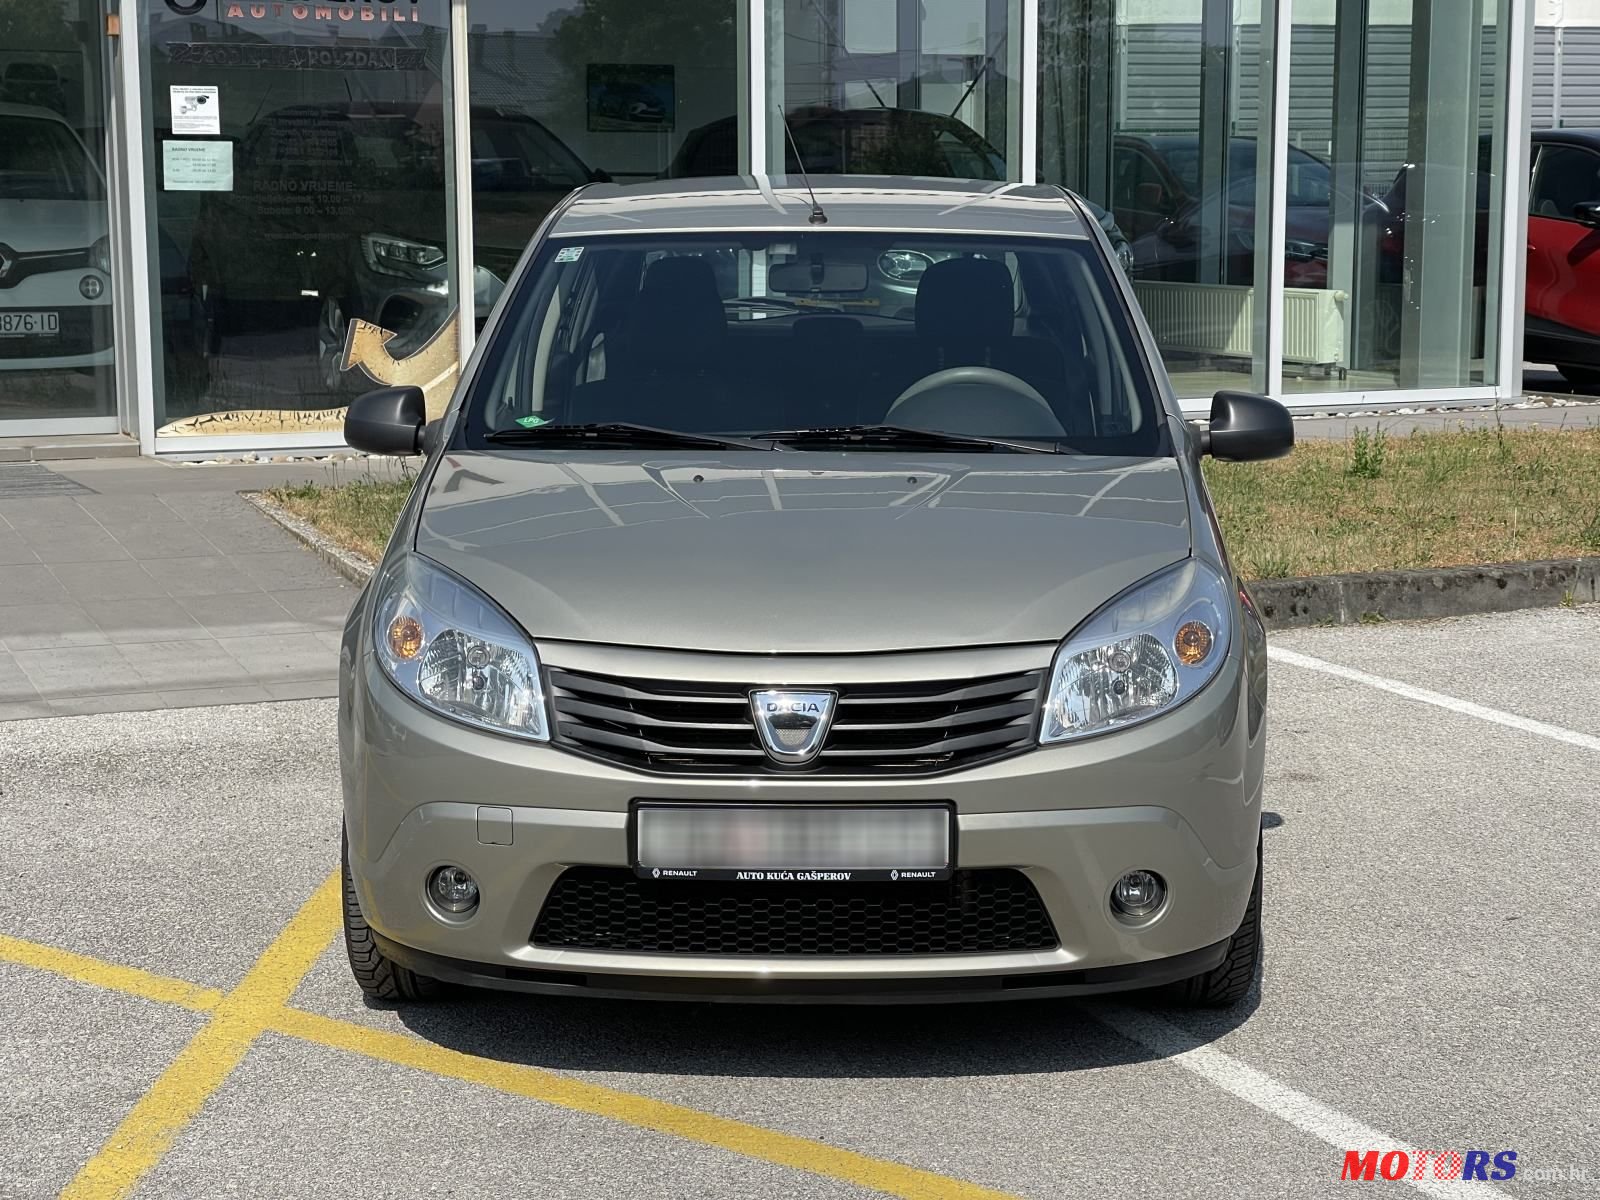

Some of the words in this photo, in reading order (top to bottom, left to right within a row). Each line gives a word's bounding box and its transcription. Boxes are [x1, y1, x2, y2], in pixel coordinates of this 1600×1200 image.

[226, 4, 420, 22] AUTOMOBILI
[766, 703, 820, 712] DACIA
[736, 871, 764, 880] AUTO
[766, 870, 794, 881] KUĆA
[797, 870, 851, 881] GAŠPEROV
